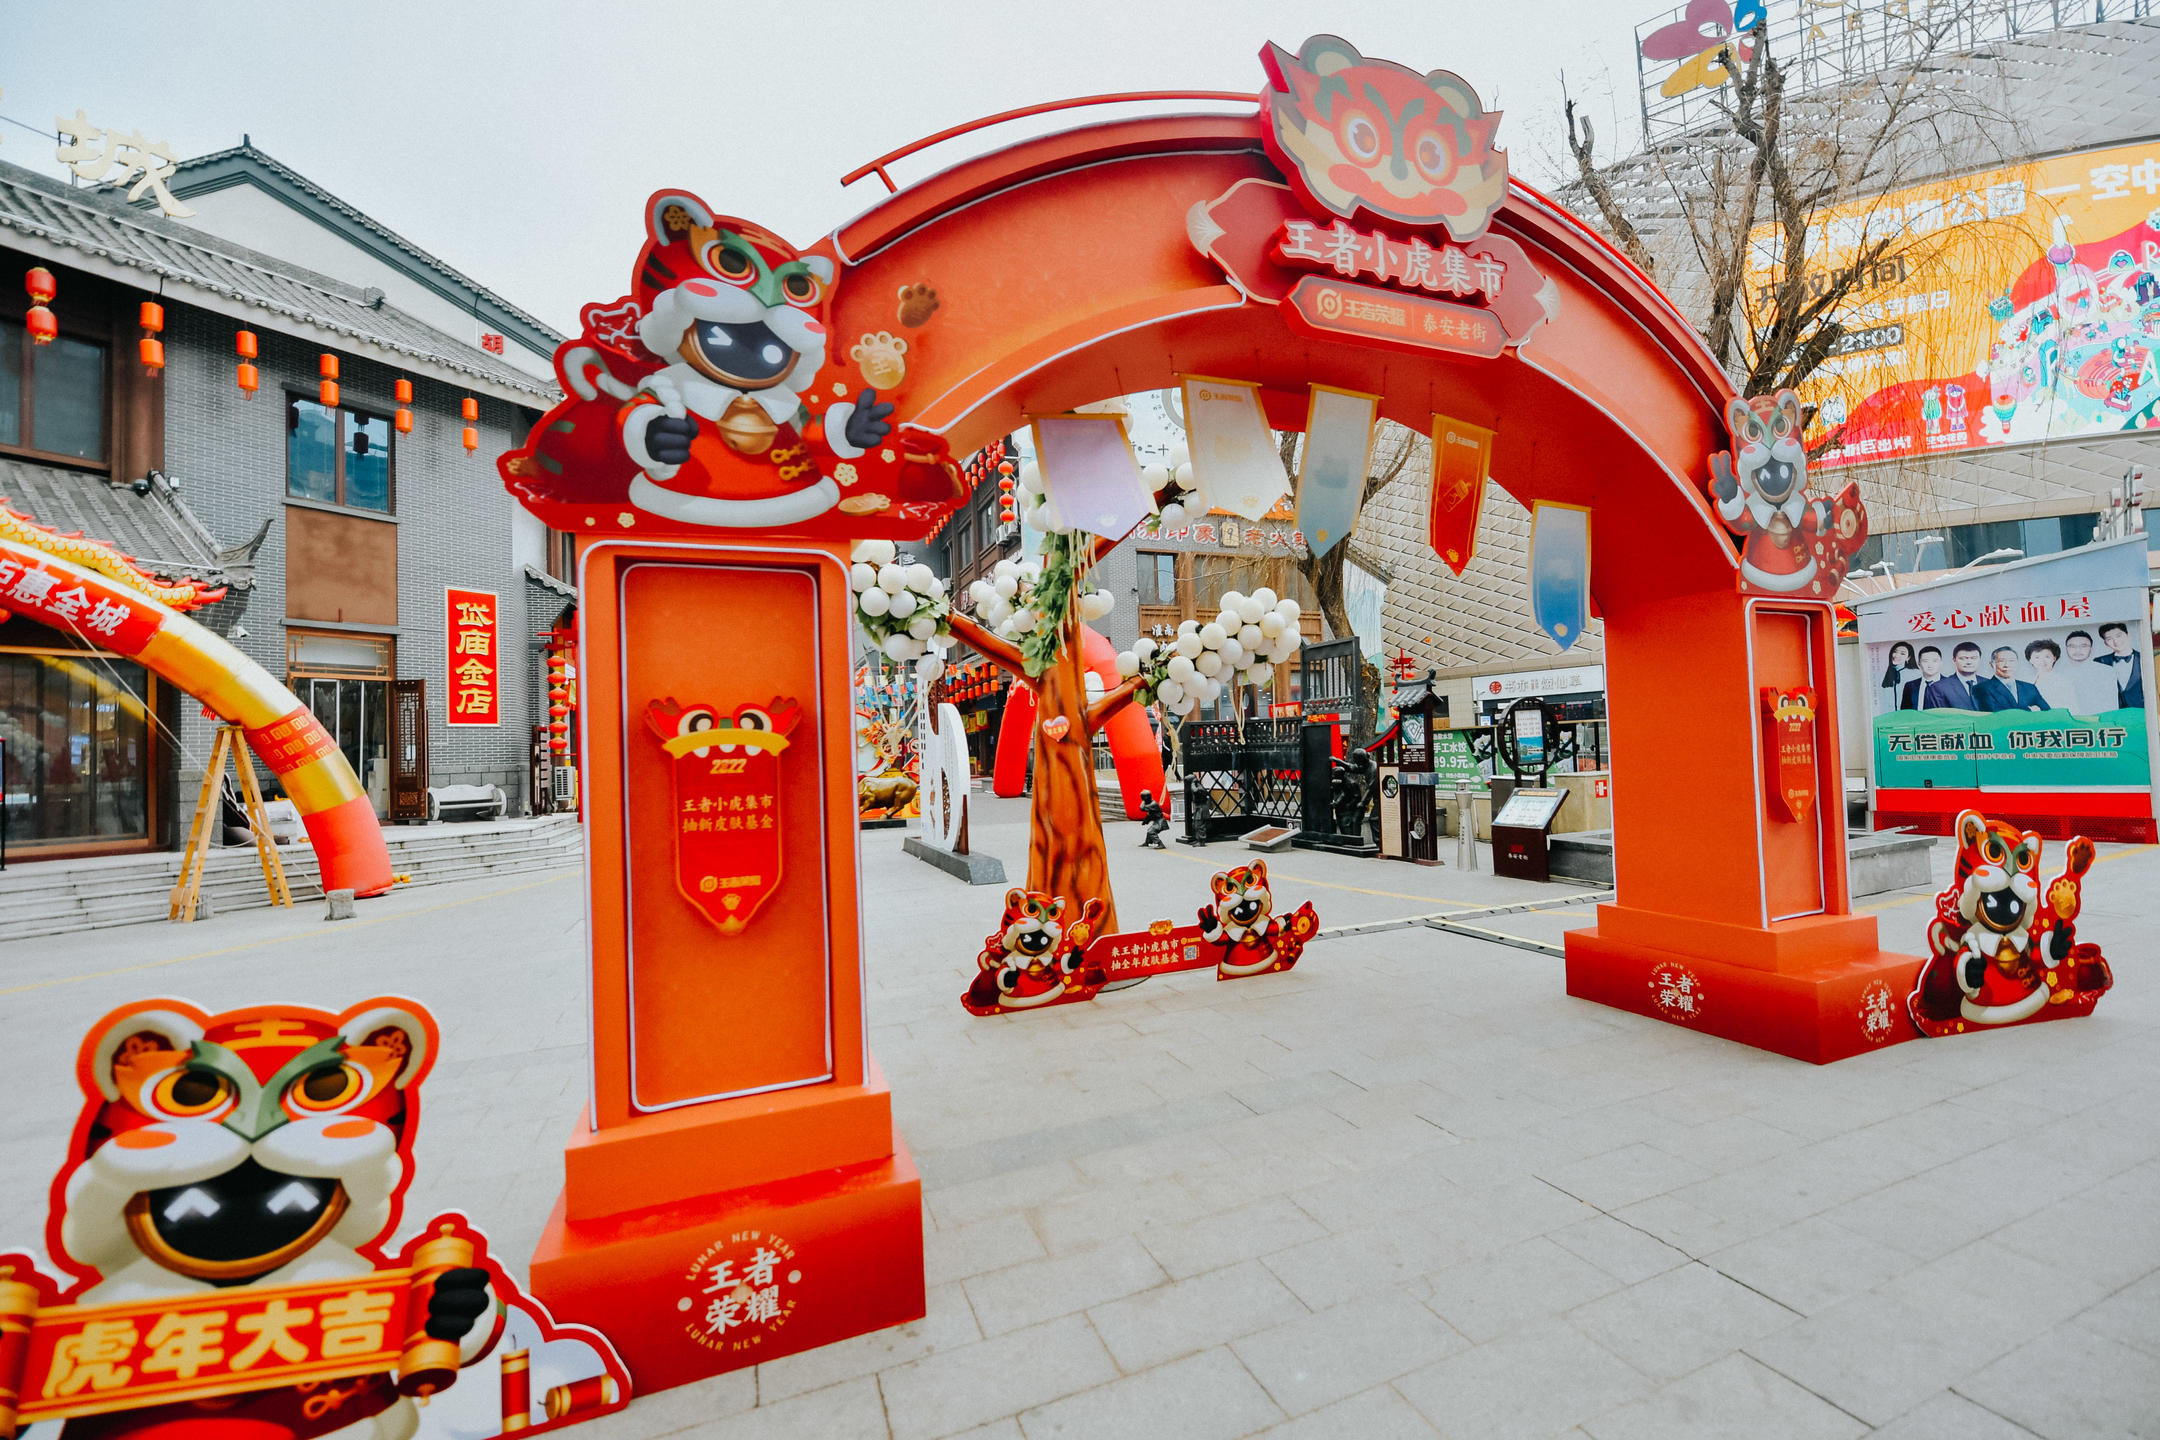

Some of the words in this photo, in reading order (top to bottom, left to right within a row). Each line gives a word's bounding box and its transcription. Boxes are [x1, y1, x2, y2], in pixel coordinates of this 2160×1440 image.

[1283, 223, 1505, 299] 王者小虎集市
[1344, 299, 1406, 327] 王者荣耀
[1423, 312, 1487, 343] 泰安老街
[1908, 596, 2092, 633] 爱心献血屋
[455, 602, 494, 714] 岱庙金店
[1888, 732, 1995, 752] 无偿献血
[2008, 726, 2128, 749] 你我同行
[682, 794, 773, 813] 王者小虎集市
[1658, 972, 1694, 994] 王者
[1660, 988, 1695, 1012] 荣耀
[685, 1240, 724, 1281] LUNAR
[731, 1230, 761, 1244] NEW
[768, 1232, 796, 1260] YEAR
[702, 1246, 782, 1294] 王者
[685, 1322, 724, 1351] LUNAR
[732, 1335, 761, 1351] NEW
[768, 1299, 796, 1332] YEAR
[704, 1284, 782, 1335] 荣耀
[41, 1290, 395, 1399] 虎年大吉
